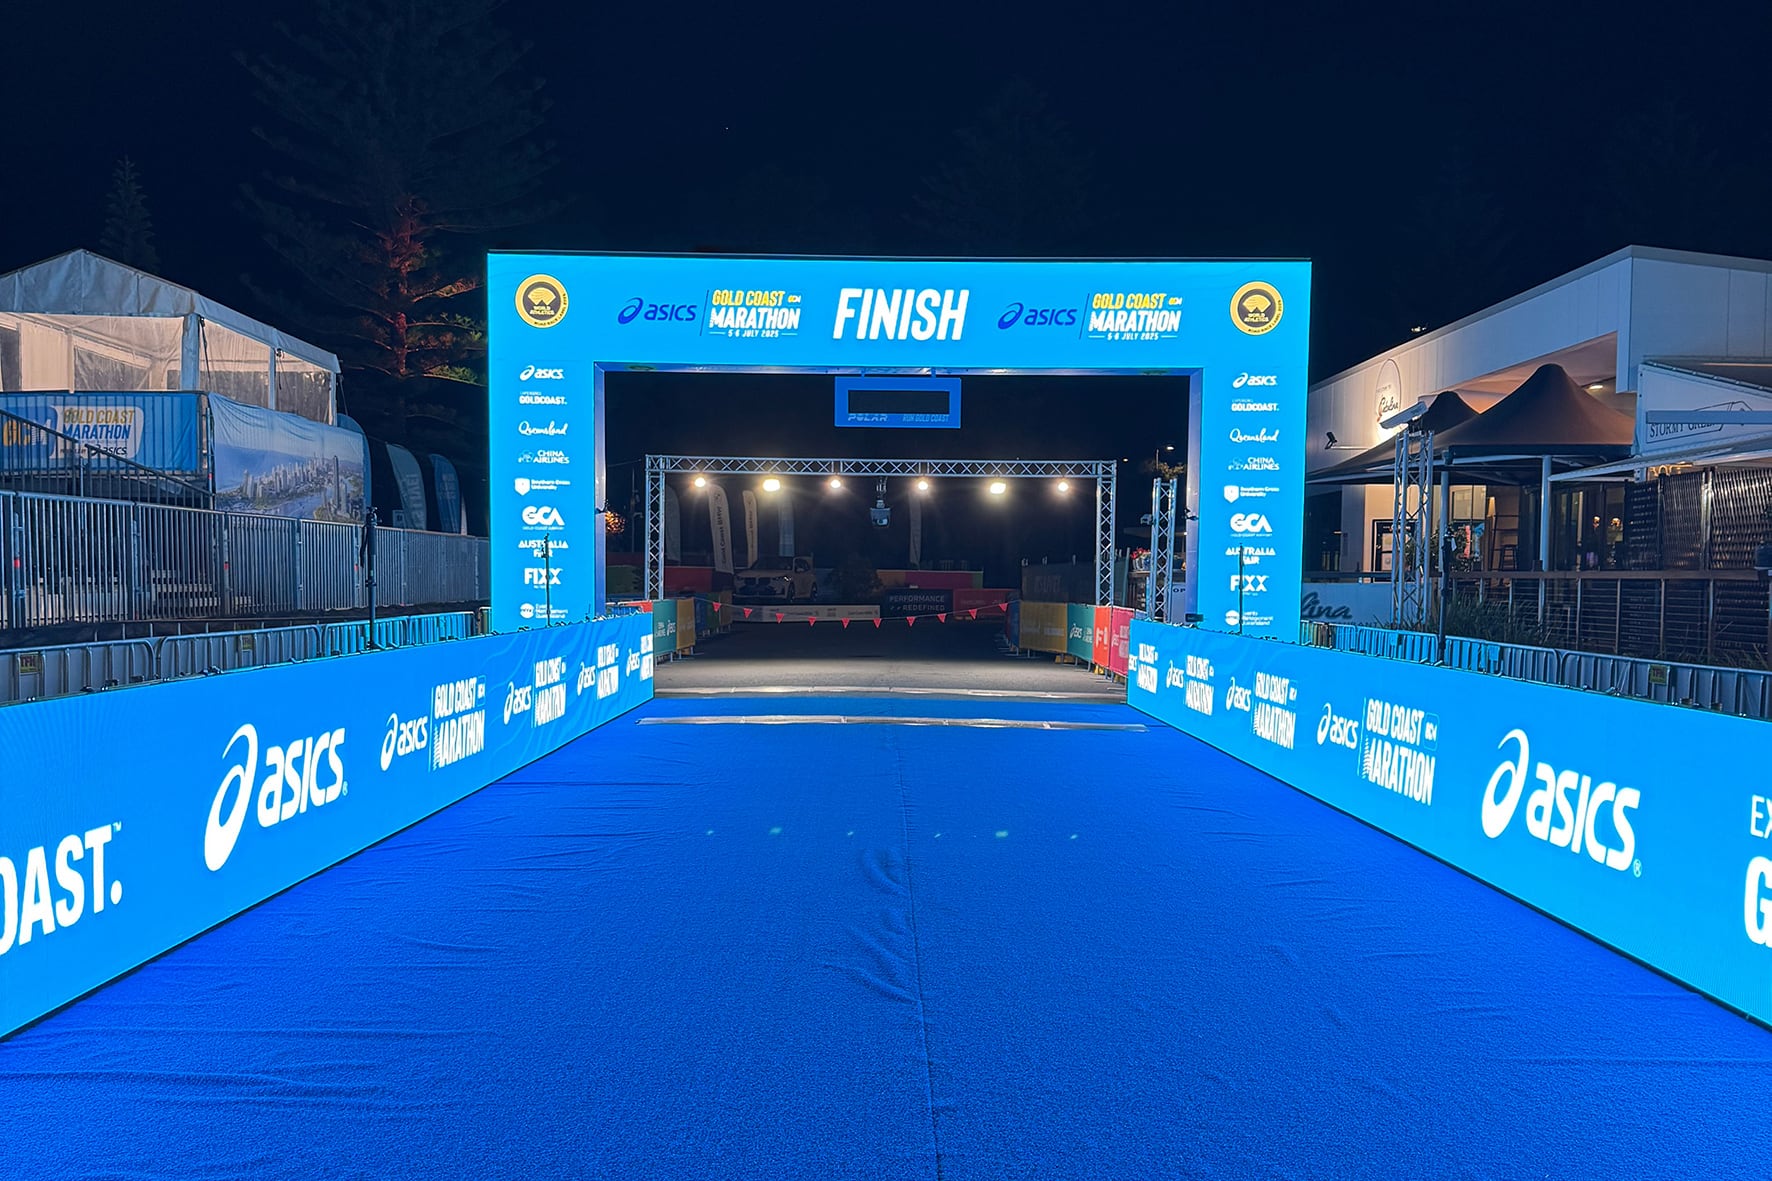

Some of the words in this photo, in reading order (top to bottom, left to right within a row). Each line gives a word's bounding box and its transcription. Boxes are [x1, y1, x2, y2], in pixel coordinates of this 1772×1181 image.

[712, 289, 744, 306] GOLD
[745, 290, 786, 307] COAST
[1092, 293, 1125, 309] GOLD
[1125, 293, 1167, 309] COAST
[709, 307, 801, 329] MARATHON
[834, 288, 970, 340] FINISH
[1088, 310, 1182, 332] MARATHON
[63, 407, 95, 425] GOLD
[96, 408, 136, 425] COAST
[62, 423, 131, 440] MARATHON
[532, 456, 570, 464] AIRLINES
[536, 449, 565, 457] CHINA
[522, 505, 566, 526] GCA
[1230, 513, 1273, 533] GCA
[889, 595, 945, 603] PERFORMANCE
[434, 682, 455, 720] GOLD
[454, 676, 477, 714] COAST
[1366, 698, 1391, 736] GOLD
[1390, 703, 1425, 747] COAST
[432, 709, 486, 772] MARATHON
[1362, 735, 1436, 807] MARATHON
